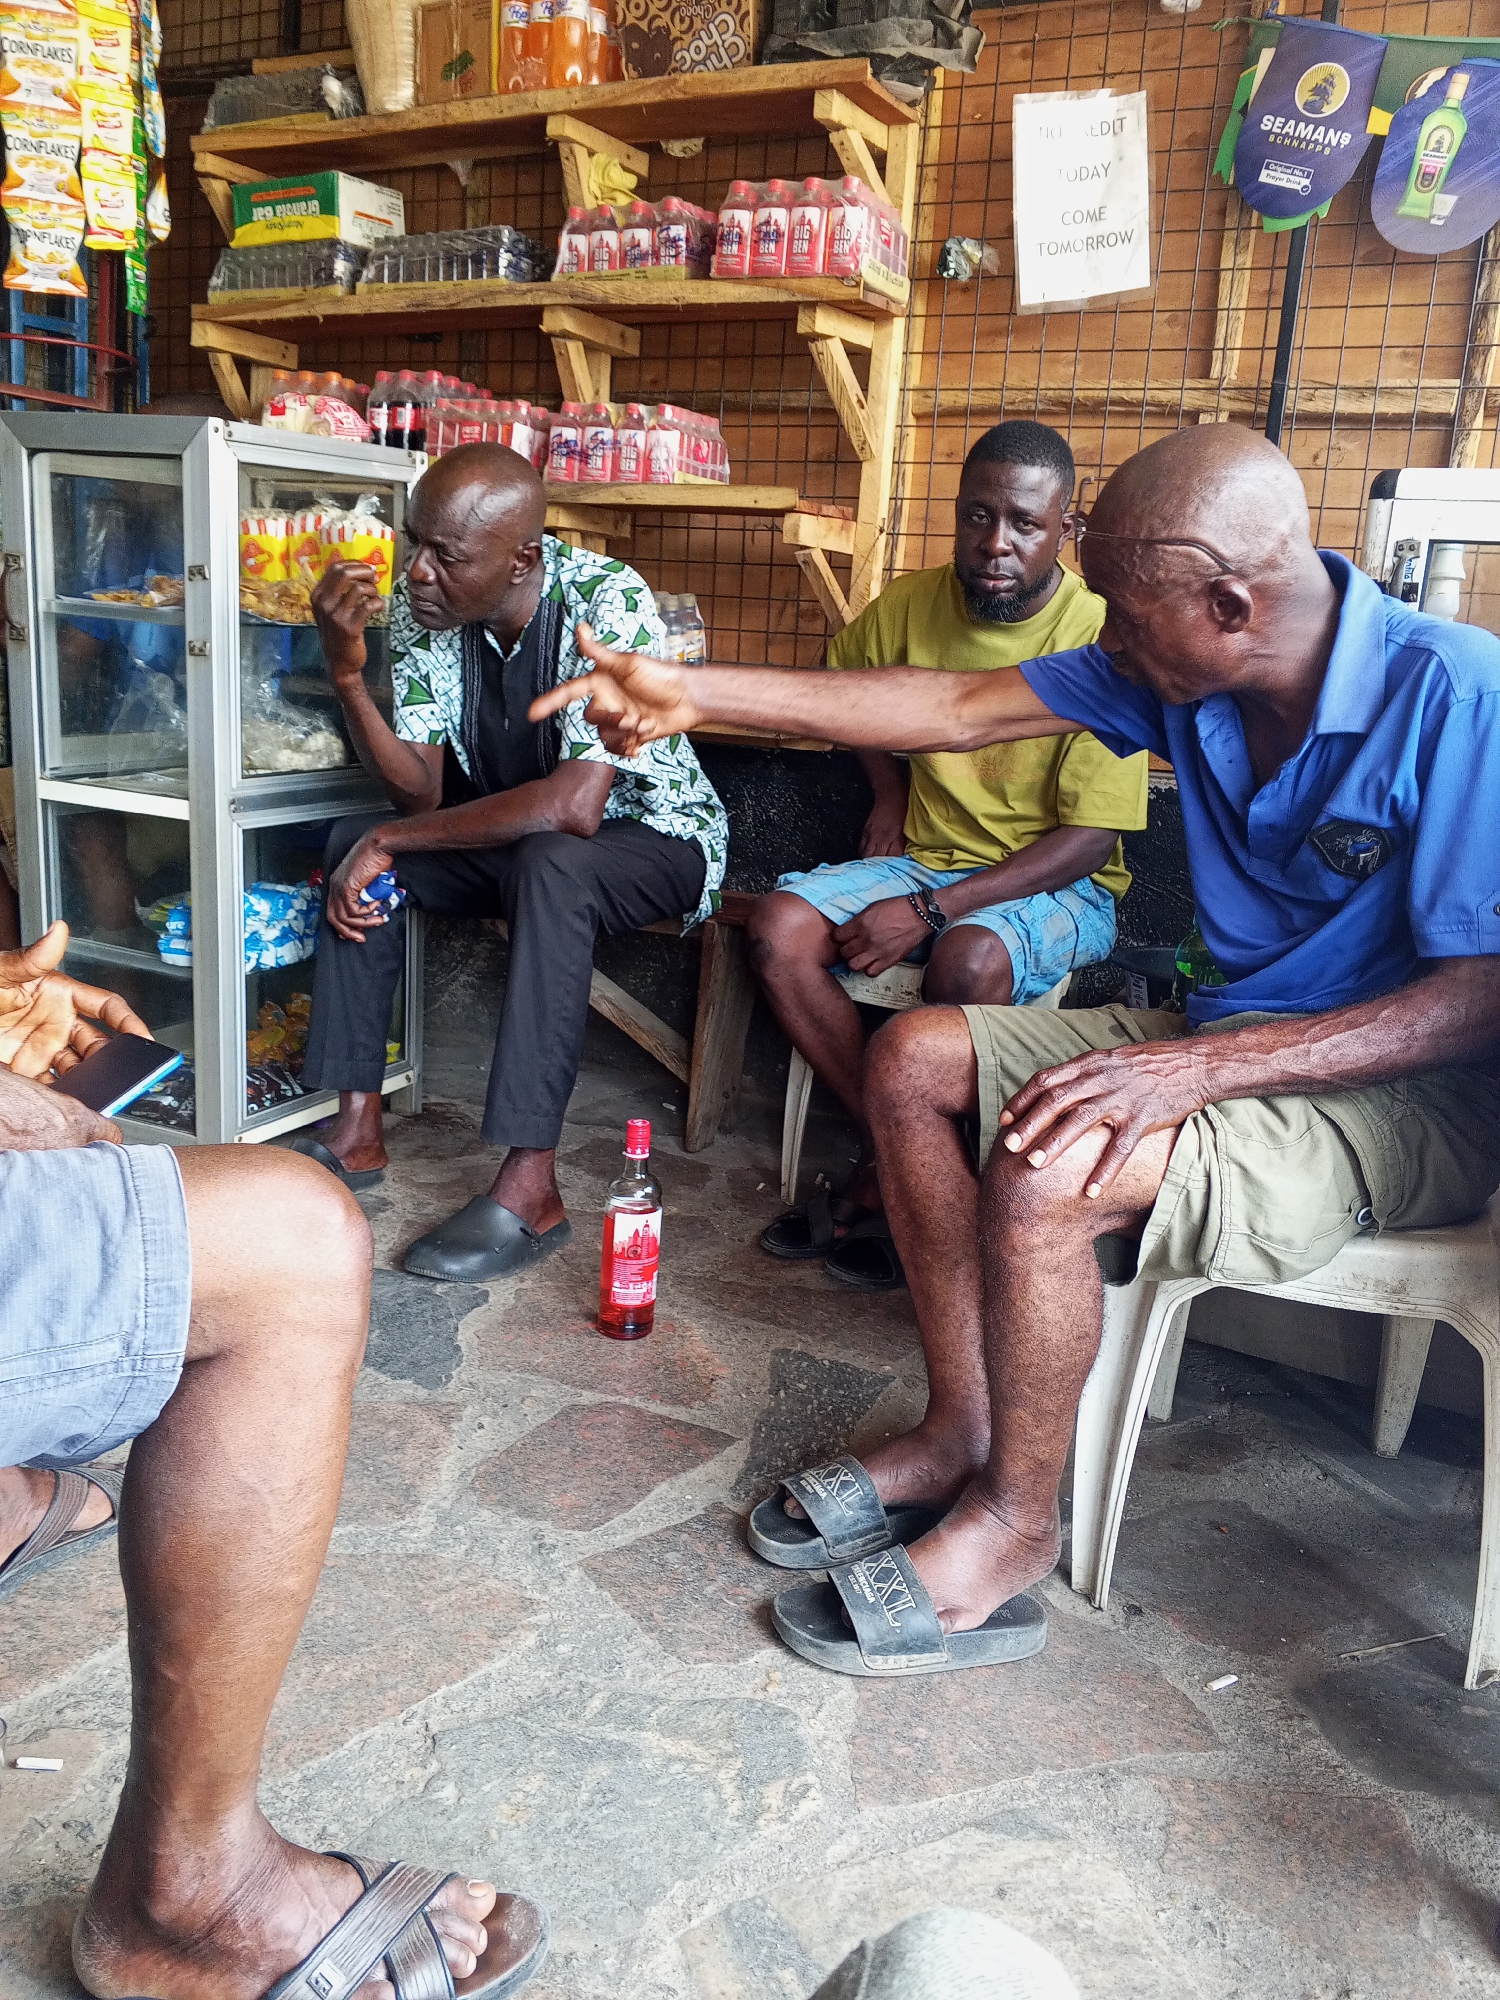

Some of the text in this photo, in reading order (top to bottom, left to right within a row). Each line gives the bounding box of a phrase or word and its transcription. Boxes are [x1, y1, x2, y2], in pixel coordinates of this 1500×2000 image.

[1, 36, 74, 64] CORNFLAKES
[675, 13, 736, 71] Choc
[1076, 116, 1127, 138] EDIT
[5, 134, 77, 161] CORNFLAKES
[1268, 134, 1331, 156] SCHNAPPS
[1268, 163, 1294, 175] Original
[1265, 172, 1302, 186] Prayer Drink
[275, 199, 321, 218] Granola
[1060, 206, 1108, 226] COME
[793, 225, 811, 240] BIG
[834, 225, 851, 240] BIG
[792, 240, 810, 254] BEN
[833, 240, 850, 254] BEN
[1036, 228, 1135, 257] TOMORROW
[621, 445, 637, 458] BIG
[620, 459, 637, 472] BEN
[862, 1550, 917, 1627] XXL
